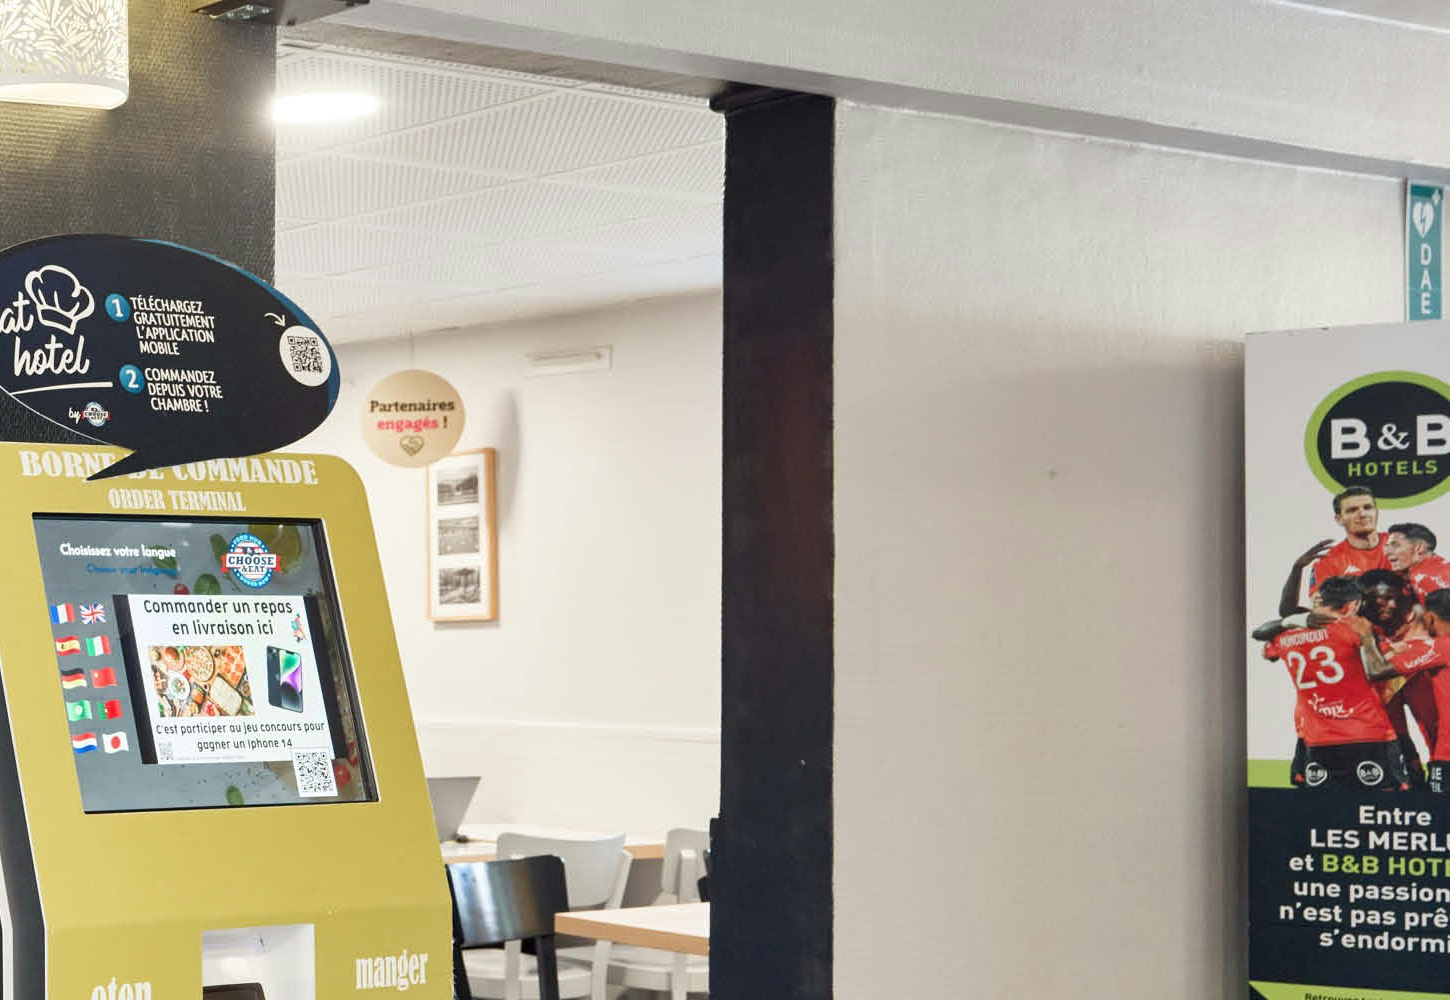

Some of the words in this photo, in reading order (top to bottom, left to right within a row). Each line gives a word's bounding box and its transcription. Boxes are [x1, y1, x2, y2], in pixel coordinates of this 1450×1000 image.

[1420, 243, 1432, 315] DAE
[112, 298, 124, 318] 1
[130, 294, 205, 314] TÉLÉCHARGEZ
[133, 311, 215, 329] GRATUITEMENT
[136, 326, 215, 343] L'APPLICATION
[14, 334, 90, 377] hotel
[139, 340, 181, 355] MOBILE
[125, 369, 139, 388] 2
[144, 367, 217, 384] COMMANDEZ
[147, 382, 186, 397] DEPUIS
[186, 384, 223, 399] VOTRE
[150, 397, 203, 412] CHAMBRE
[370, 398, 455, 413] Partenaires
[68, 407, 81, 424] by
[377, 416, 439, 432] engagés
[1348, 460, 1438, 477] HOTELS
[108, 487, 166, 511] ORDER
[168, 489, 247, 512] TERMINAL
[59, 543, 112, 557] Choisissez
[113, 546, 140, 557] votre
[141, 544, 177, 560] langue
[228, 556, 275, 566] CHOOSE
[143, 599, 228, 614] Commander
[232, 601, 250, 613] un
[254, 601, 293, 616] repas
[172, 623, 189, 635] en
[192, 619, 254, 635] livraison
[257, 619, 274, 635] ici
[1287, 645, 1345, 690] 23
[156, 723, 178, 735] C'est
[180, 721, 227, 736] participer
[230, 722, 242, 733] au
[243, 720, 258, 735] jeu
[260, 721, 302, 733] concours
[304, 721, 326, 734] pour
[197, 740, 230, 753] gagner
[233, 739, 246, 749] un
[281, 738, 294, 748] 14
[1359, 805, 1432, 826] Entre
[1310, 829, 1360, 849] LES
[1368, 831, 1450, 852] MERL
[1289, 854, 1314, 872] et
[1323, 854, 1380, 874] B&B
[1294, 881, 1341, 898] une
[1349, 883, 1450, 903] passion
[1279, 902, 1343, 923] n'est
[1351, 909, 1396, 928] pas
[1404, 907, 1450, 931] prê
[355, 949, 429, 991] manger
